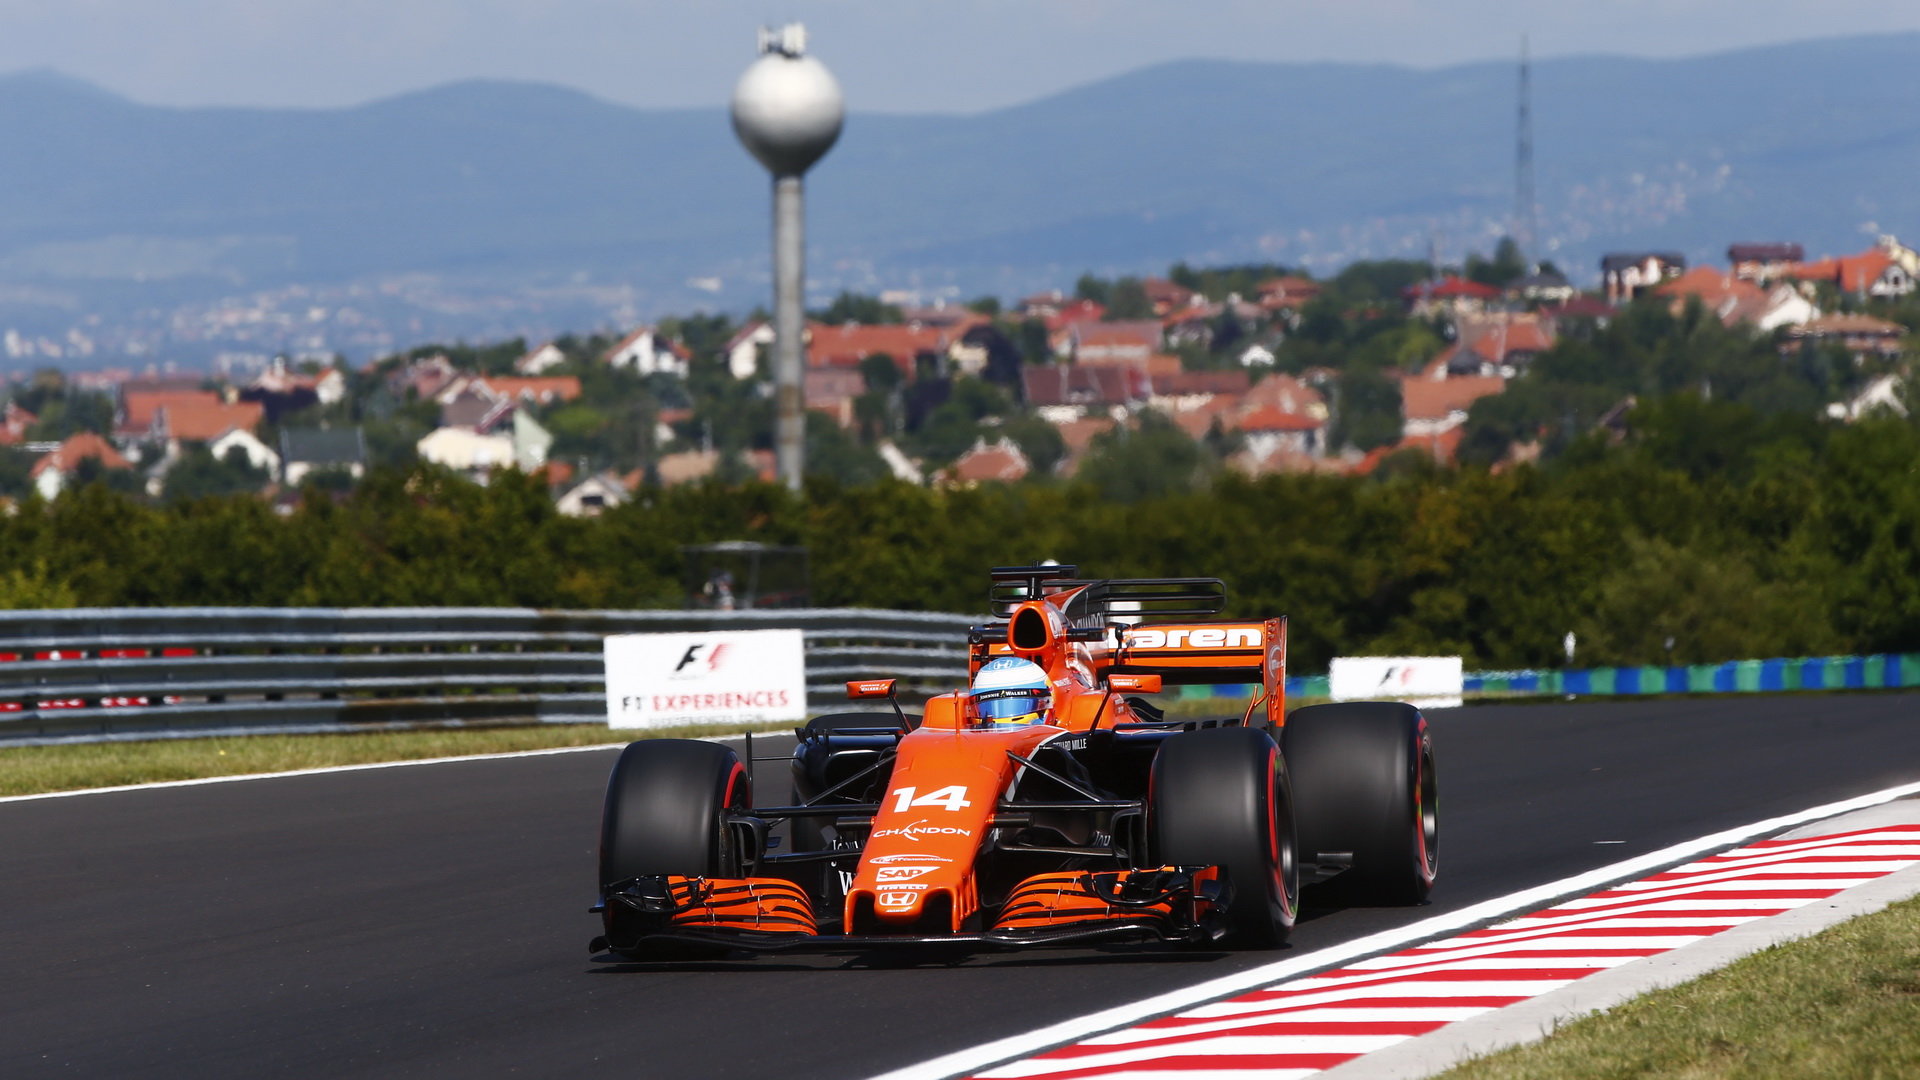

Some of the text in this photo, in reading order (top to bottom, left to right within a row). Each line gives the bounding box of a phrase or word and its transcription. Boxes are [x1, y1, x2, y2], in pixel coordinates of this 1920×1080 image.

[1108, 627, 1263, 649] aren
[622, 690, 789, 712] F1 EXPERIENCES
[892, 785, 971, 813] 14
[872, 824, 971, 840] CHANDON
[879, 869, 923, 879] SAP
